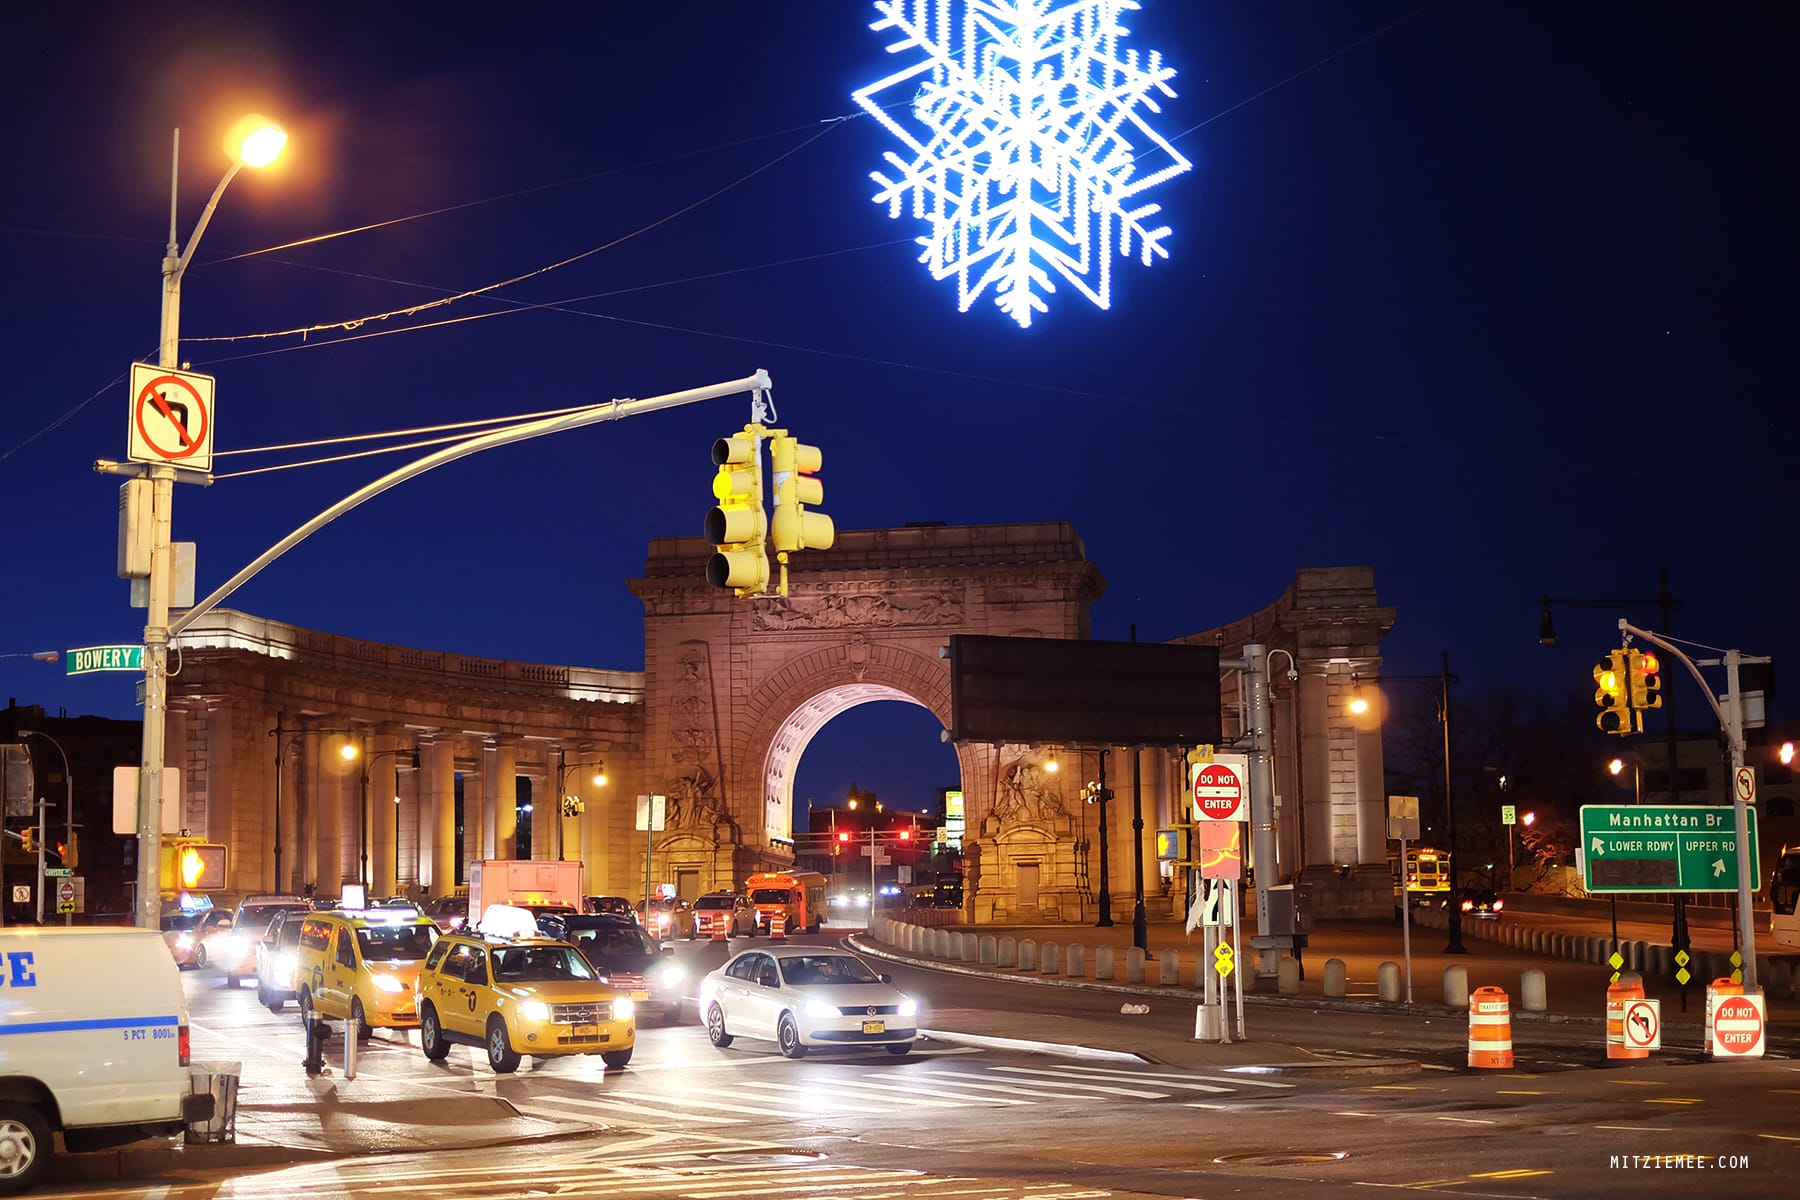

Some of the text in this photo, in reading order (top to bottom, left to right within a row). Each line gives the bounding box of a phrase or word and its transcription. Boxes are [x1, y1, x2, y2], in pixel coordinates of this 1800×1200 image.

[76, 649, 132, 670] BOWERY
[1201, 775, 1235, 784] DO NOT
[1204, 800, 1232, 809] ENTER
[1609, 813, 1723, 827] Manhattan Br
[1609, 841, 1674, 851] LOWER RDWY
[1686, 841, 1735, 851] UPPER RD
[0, 952, 36, 988] E
[1721, 1007, 1753, 1017] DO NOT
[132, 1029, 145, 1040] PCT
[1724, 1033, 1752, 1043] ENTER
